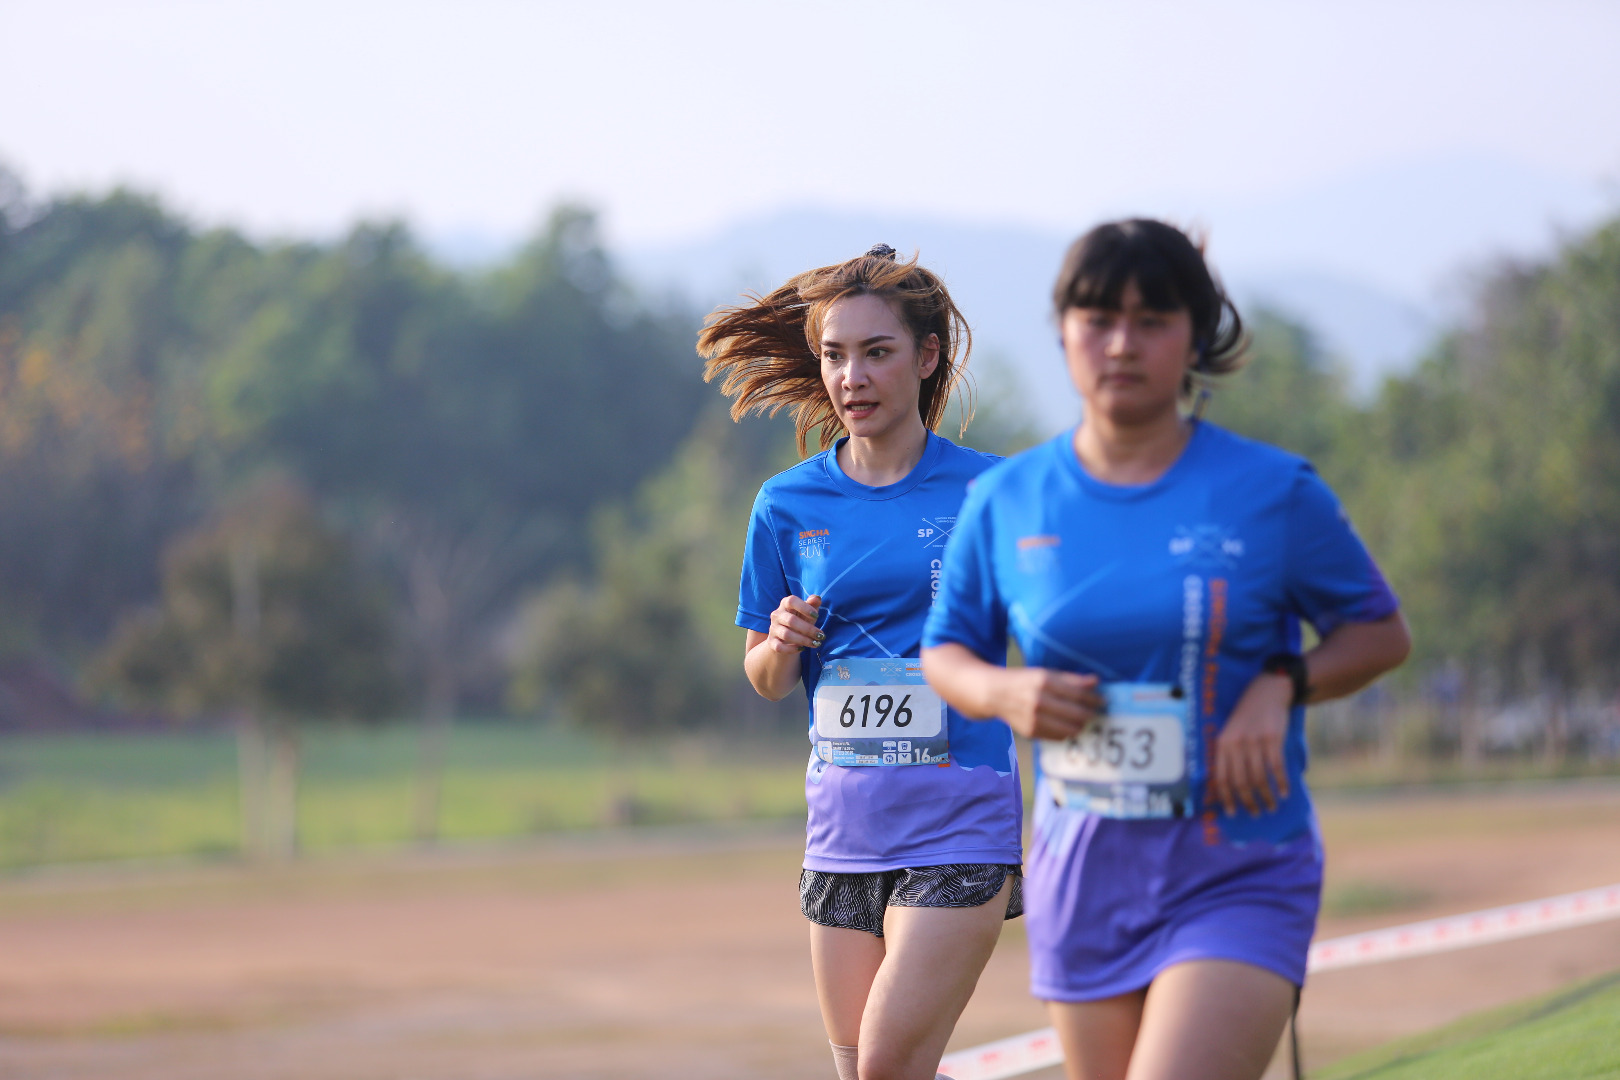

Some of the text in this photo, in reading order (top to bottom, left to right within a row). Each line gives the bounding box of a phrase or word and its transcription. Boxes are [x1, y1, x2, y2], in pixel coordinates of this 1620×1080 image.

[799, 529, 830, 540] SINGHA
[917, 528, 934, 538] SP
[799, 536, 823, 547] SERIES
[839, 694, 913, 728] 6196
[914, 747, 931, 764] 16
